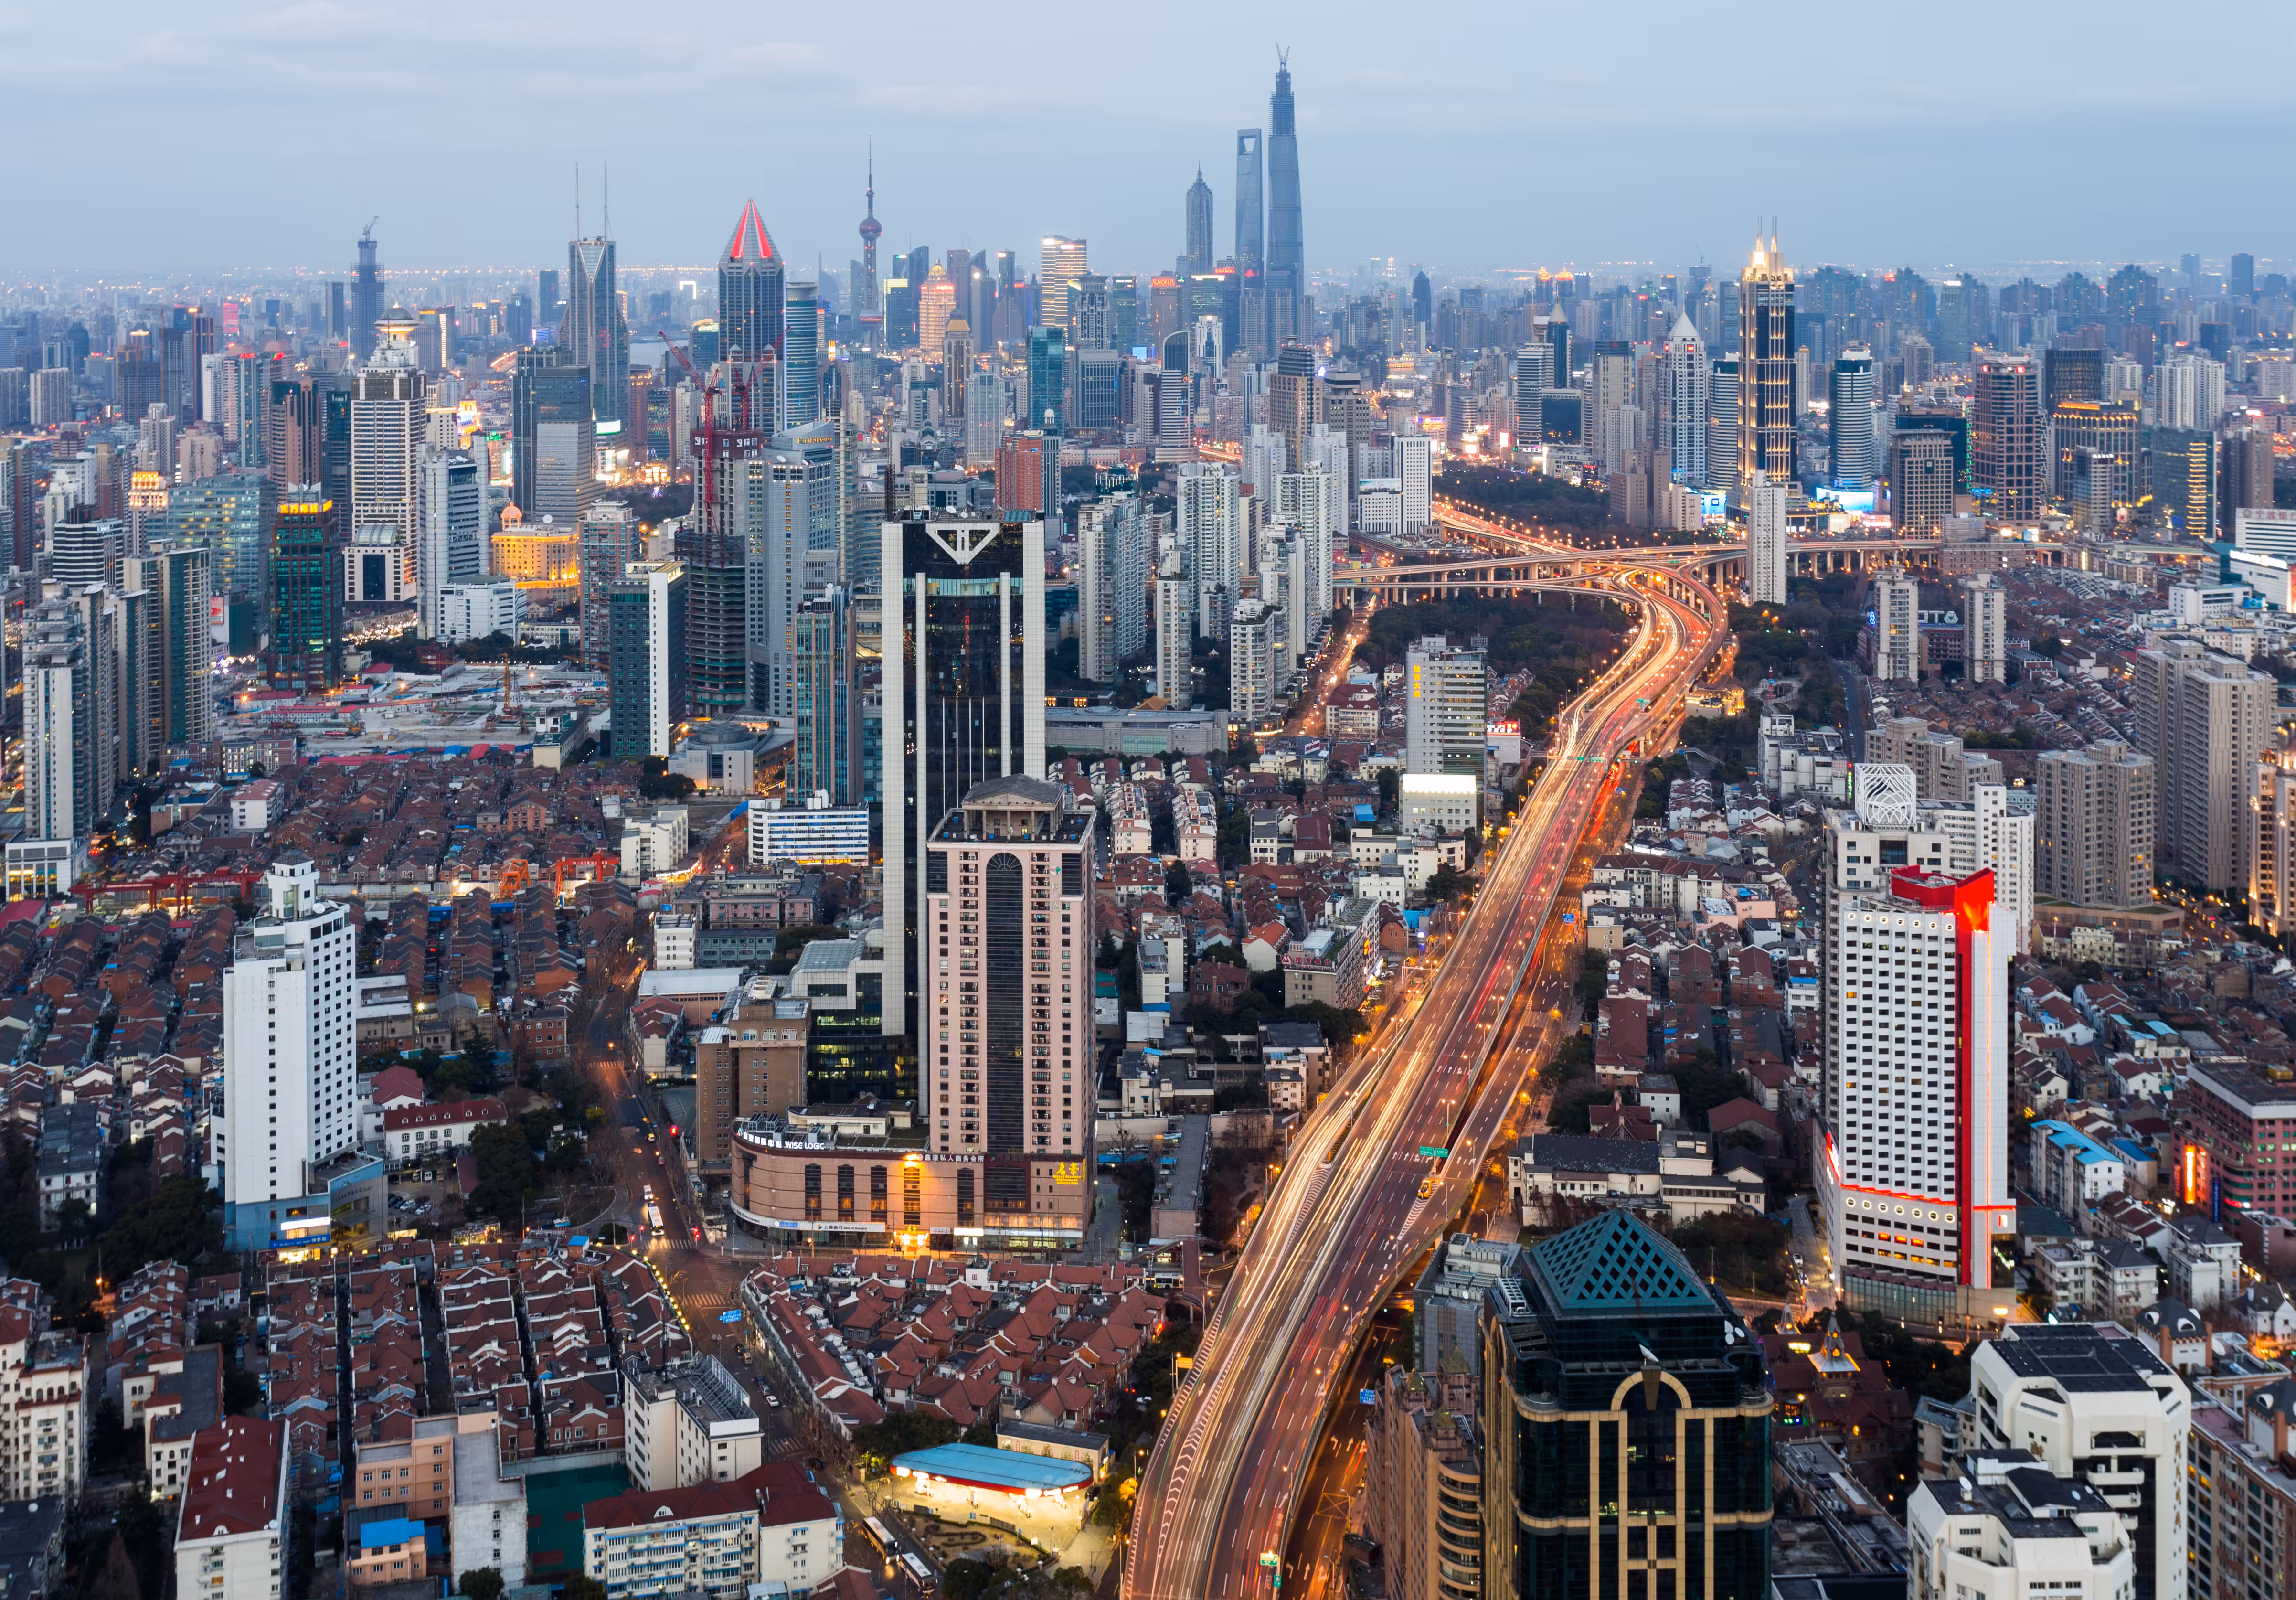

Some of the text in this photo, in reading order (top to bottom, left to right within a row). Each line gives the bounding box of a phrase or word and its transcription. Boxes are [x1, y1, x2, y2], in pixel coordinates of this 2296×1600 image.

[1295, 956, 1331, 965] 招商银行
[785, 1141, 825, 1150] WISE LOGIC
